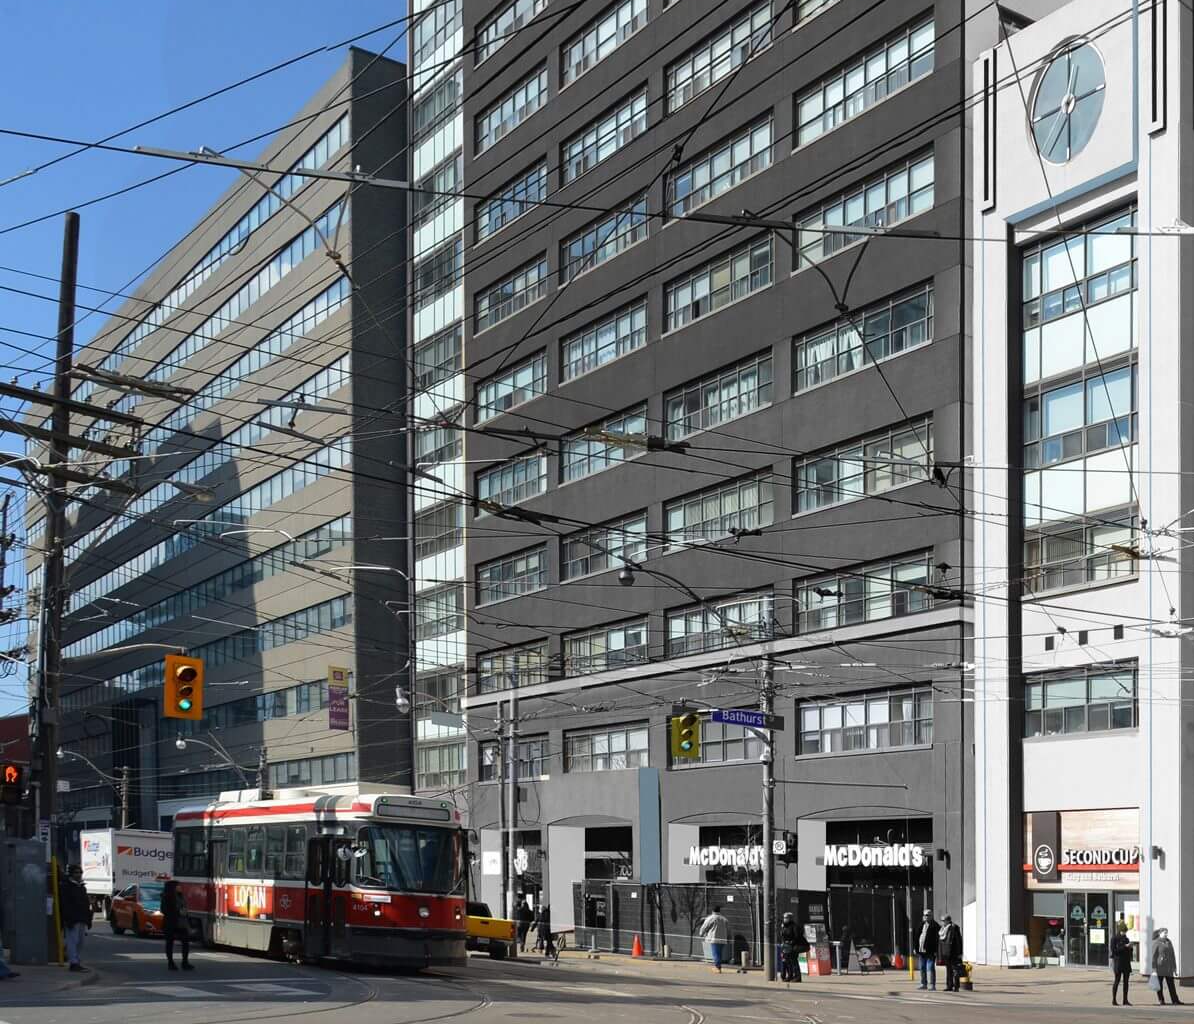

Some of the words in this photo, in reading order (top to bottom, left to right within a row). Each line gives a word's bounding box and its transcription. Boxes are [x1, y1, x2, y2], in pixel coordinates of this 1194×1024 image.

[722, 711, 763, 725] Bathurs
[133, 847, 174, 861] Budge
[823, 843, 923, 867] McDonald's
[1063, 850, 1110, 865] SECOND
[1110, 850, 1139, 865] CUP
[234, 885, 266, 909] LOGAN
[352, 902, 368, 912] 4104
